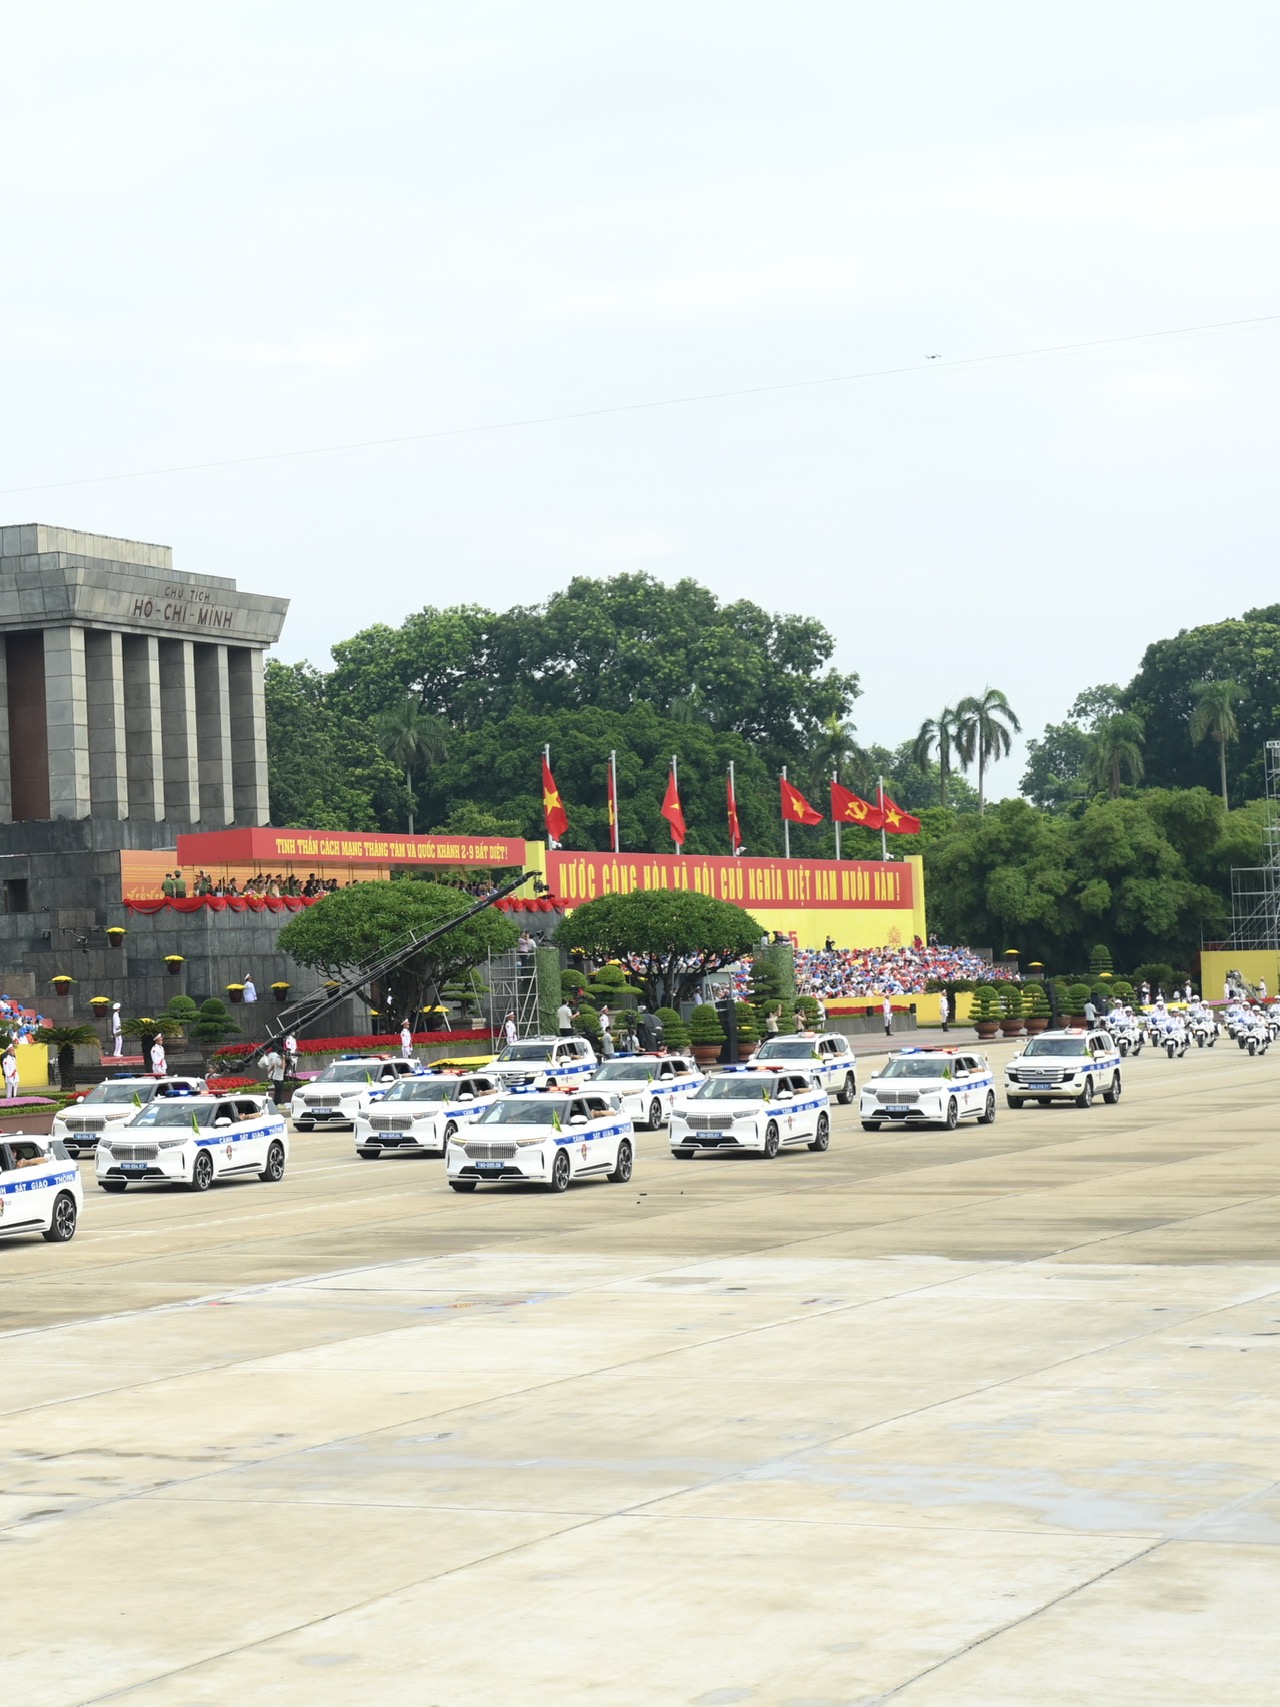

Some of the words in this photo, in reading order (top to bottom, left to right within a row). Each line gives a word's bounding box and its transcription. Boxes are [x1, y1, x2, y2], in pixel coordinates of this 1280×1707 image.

[276, 838, 296, 854] TINH
[461, 844, 474, 859] 2-9
[559, 858, 596, 899] NƯỚC
[720, 861, 743, 900] CHỦ
[749, 864, 783, 900] NGHĨA
[787, 864, 810, 907] VIỆT
[815, 869, 838, 901] NAM
[842, 866, 870, 901] MUÔN
[15, 1182, 26, 1192] SÁT
[31, 1180, 48, 1190] GIAO
